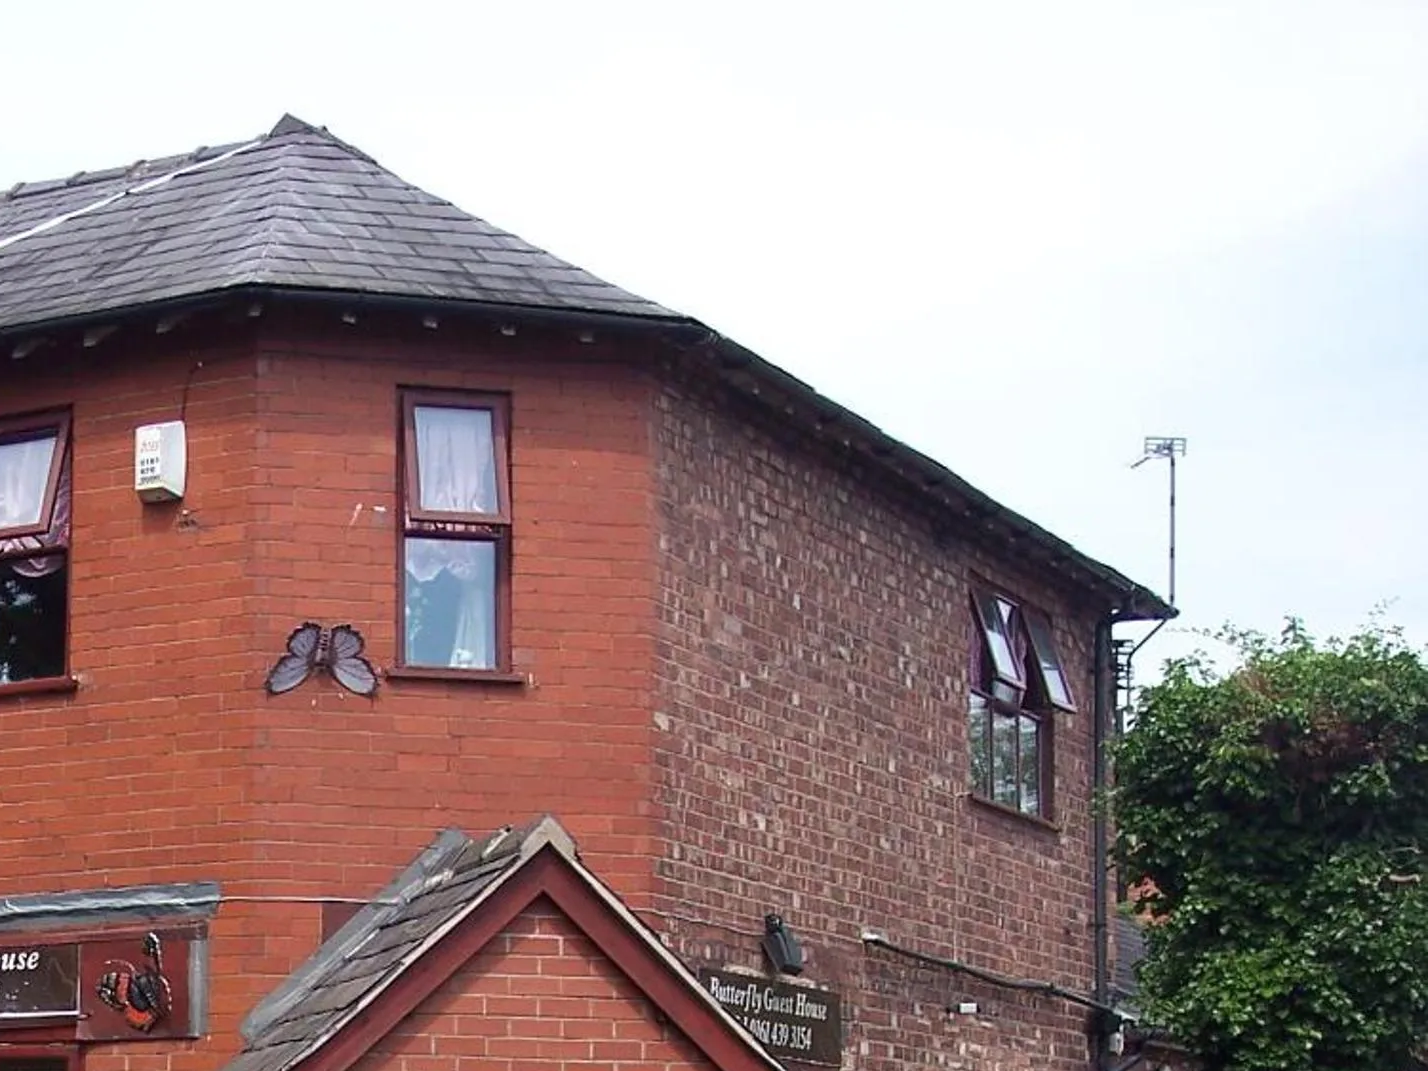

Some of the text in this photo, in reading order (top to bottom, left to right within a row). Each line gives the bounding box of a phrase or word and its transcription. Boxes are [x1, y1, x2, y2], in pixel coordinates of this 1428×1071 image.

[710, 976, 827, 1020] Butterfly Guest House
[772, 1022, 789, 1046] 439
[790, 1025, 812, 1050] 3154
